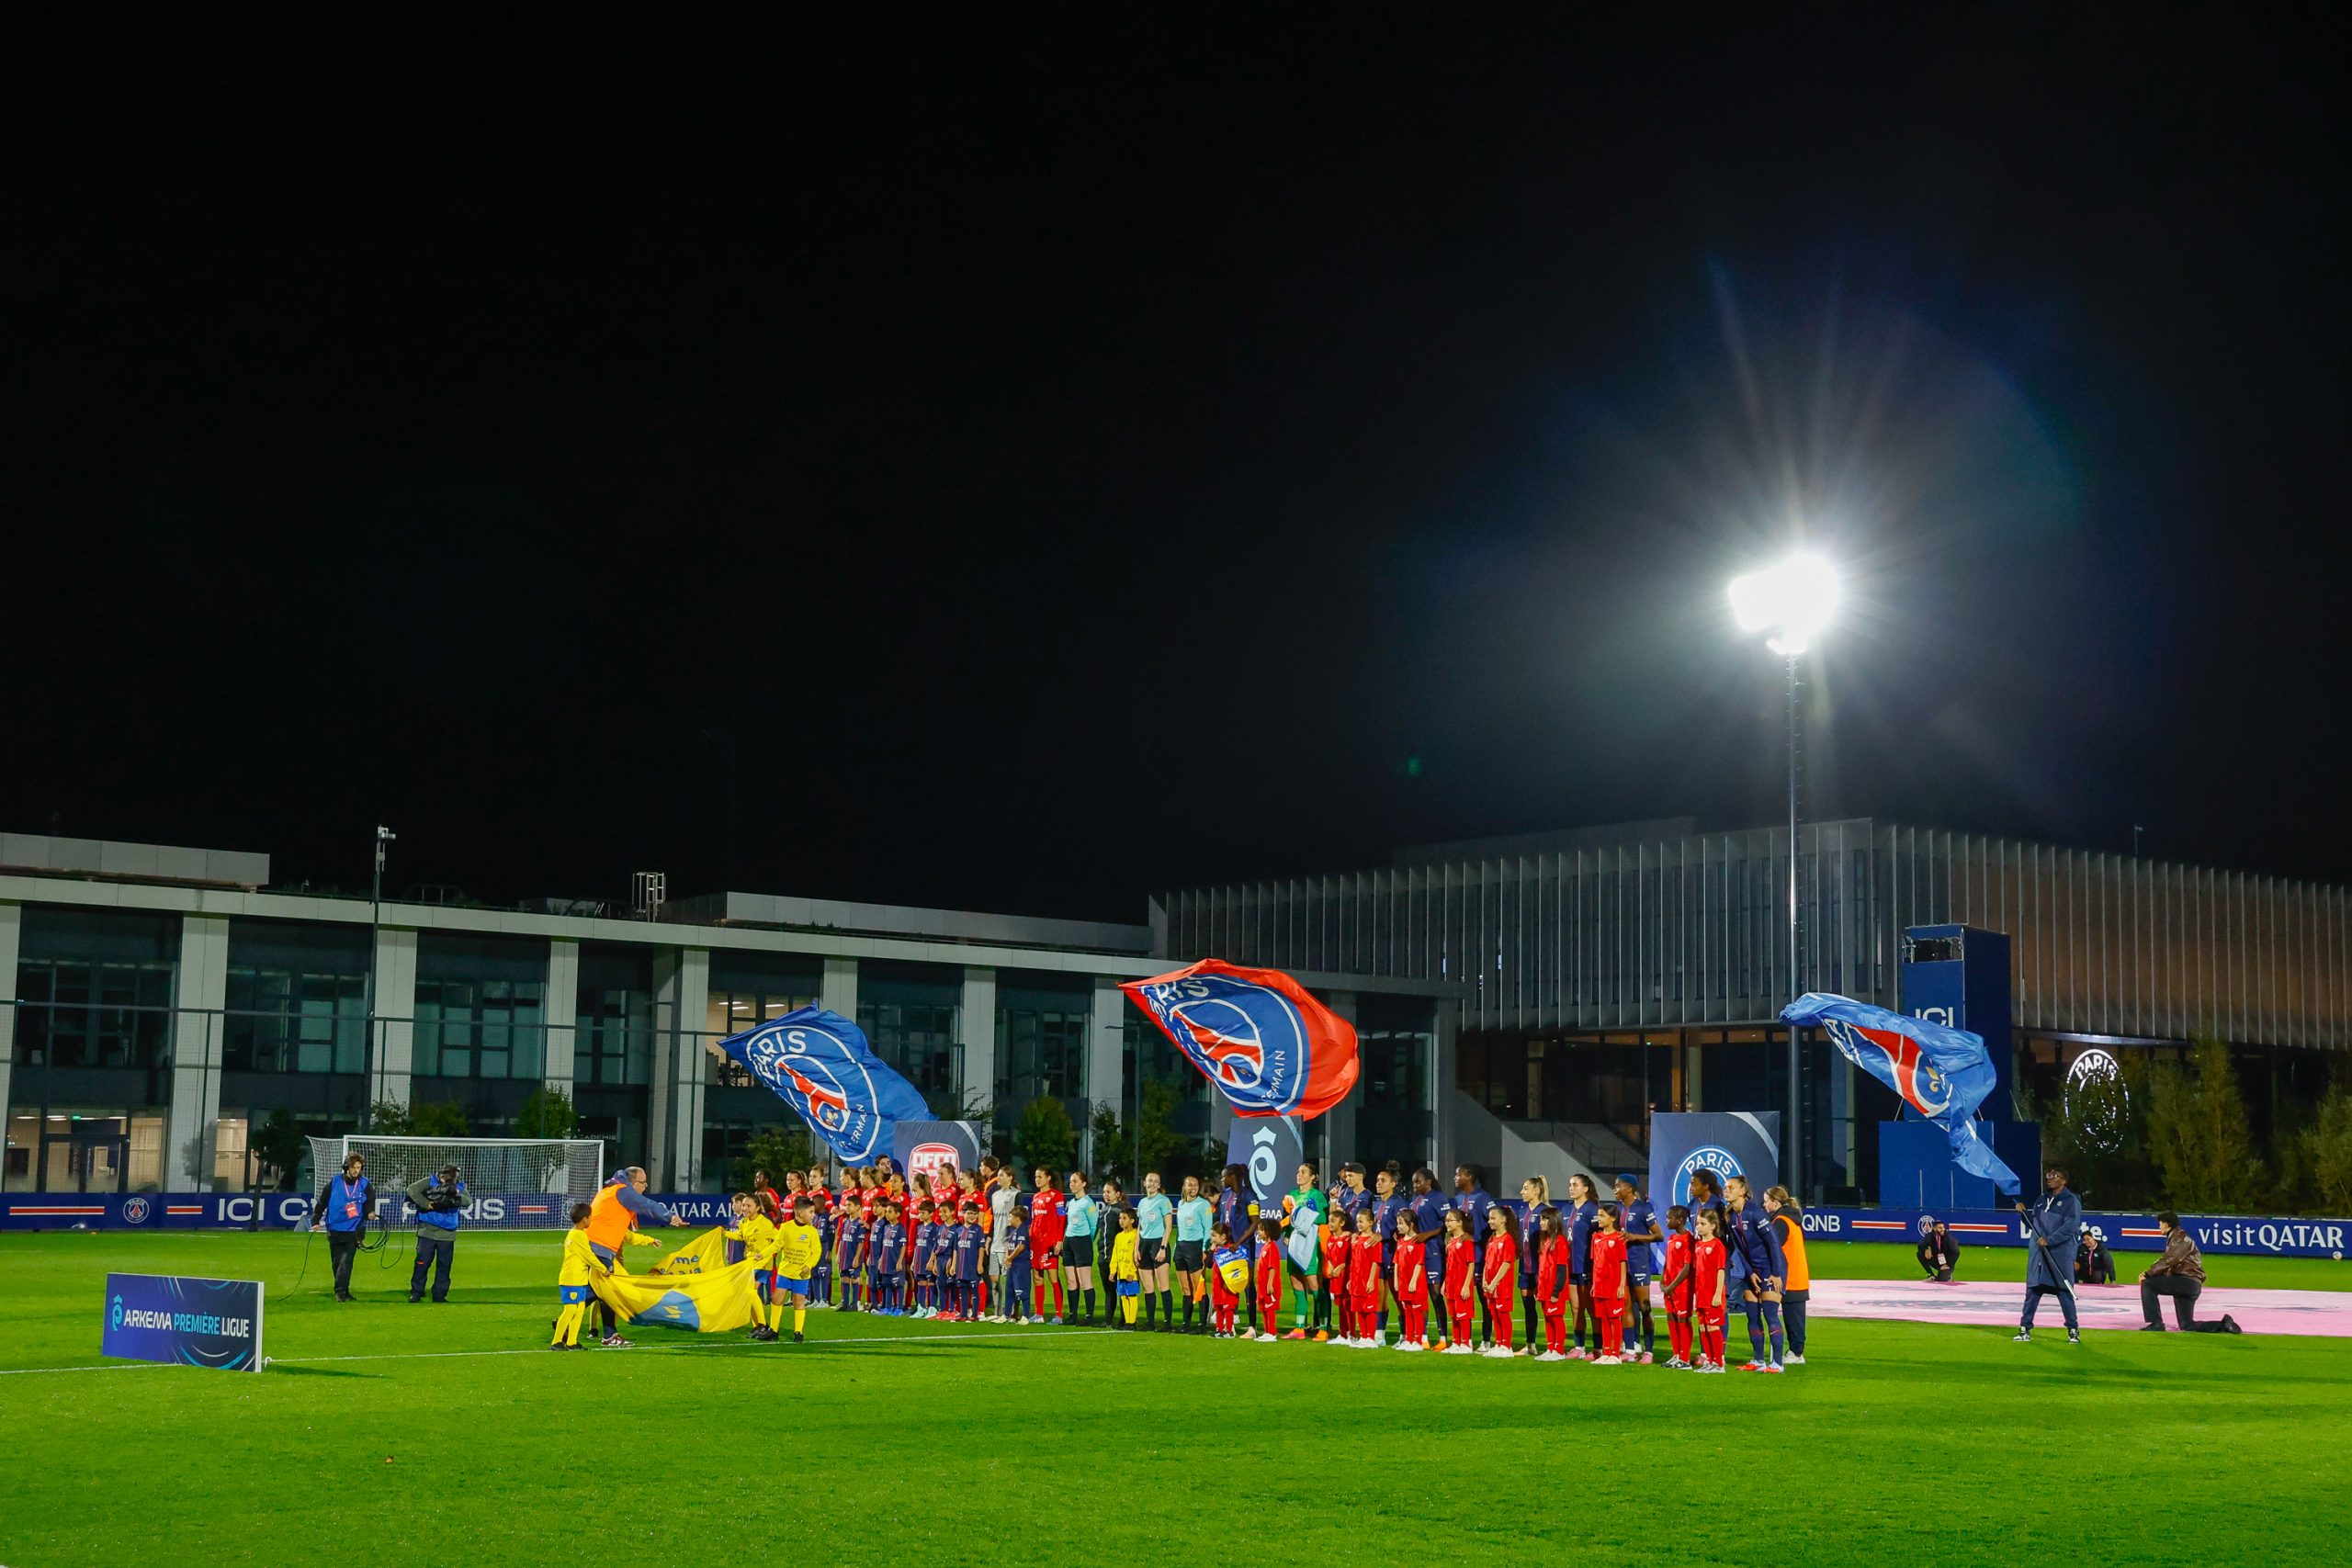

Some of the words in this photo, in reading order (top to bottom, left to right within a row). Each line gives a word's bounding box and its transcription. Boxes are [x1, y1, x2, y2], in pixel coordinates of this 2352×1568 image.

[2075, 1055, 2117, 1081] PARIS
[1684, 1153, 1733, 1175] PARIS
[217, 1198, 265, 1221] ICI
[1801, 1213, 1840, 1233] QNB
[123, 1308, 172, 1330] ARKEMA
[174, 1312, 220, 1336] PREMIÈRE
[221, 1316, 250, 1338] LIGUE
